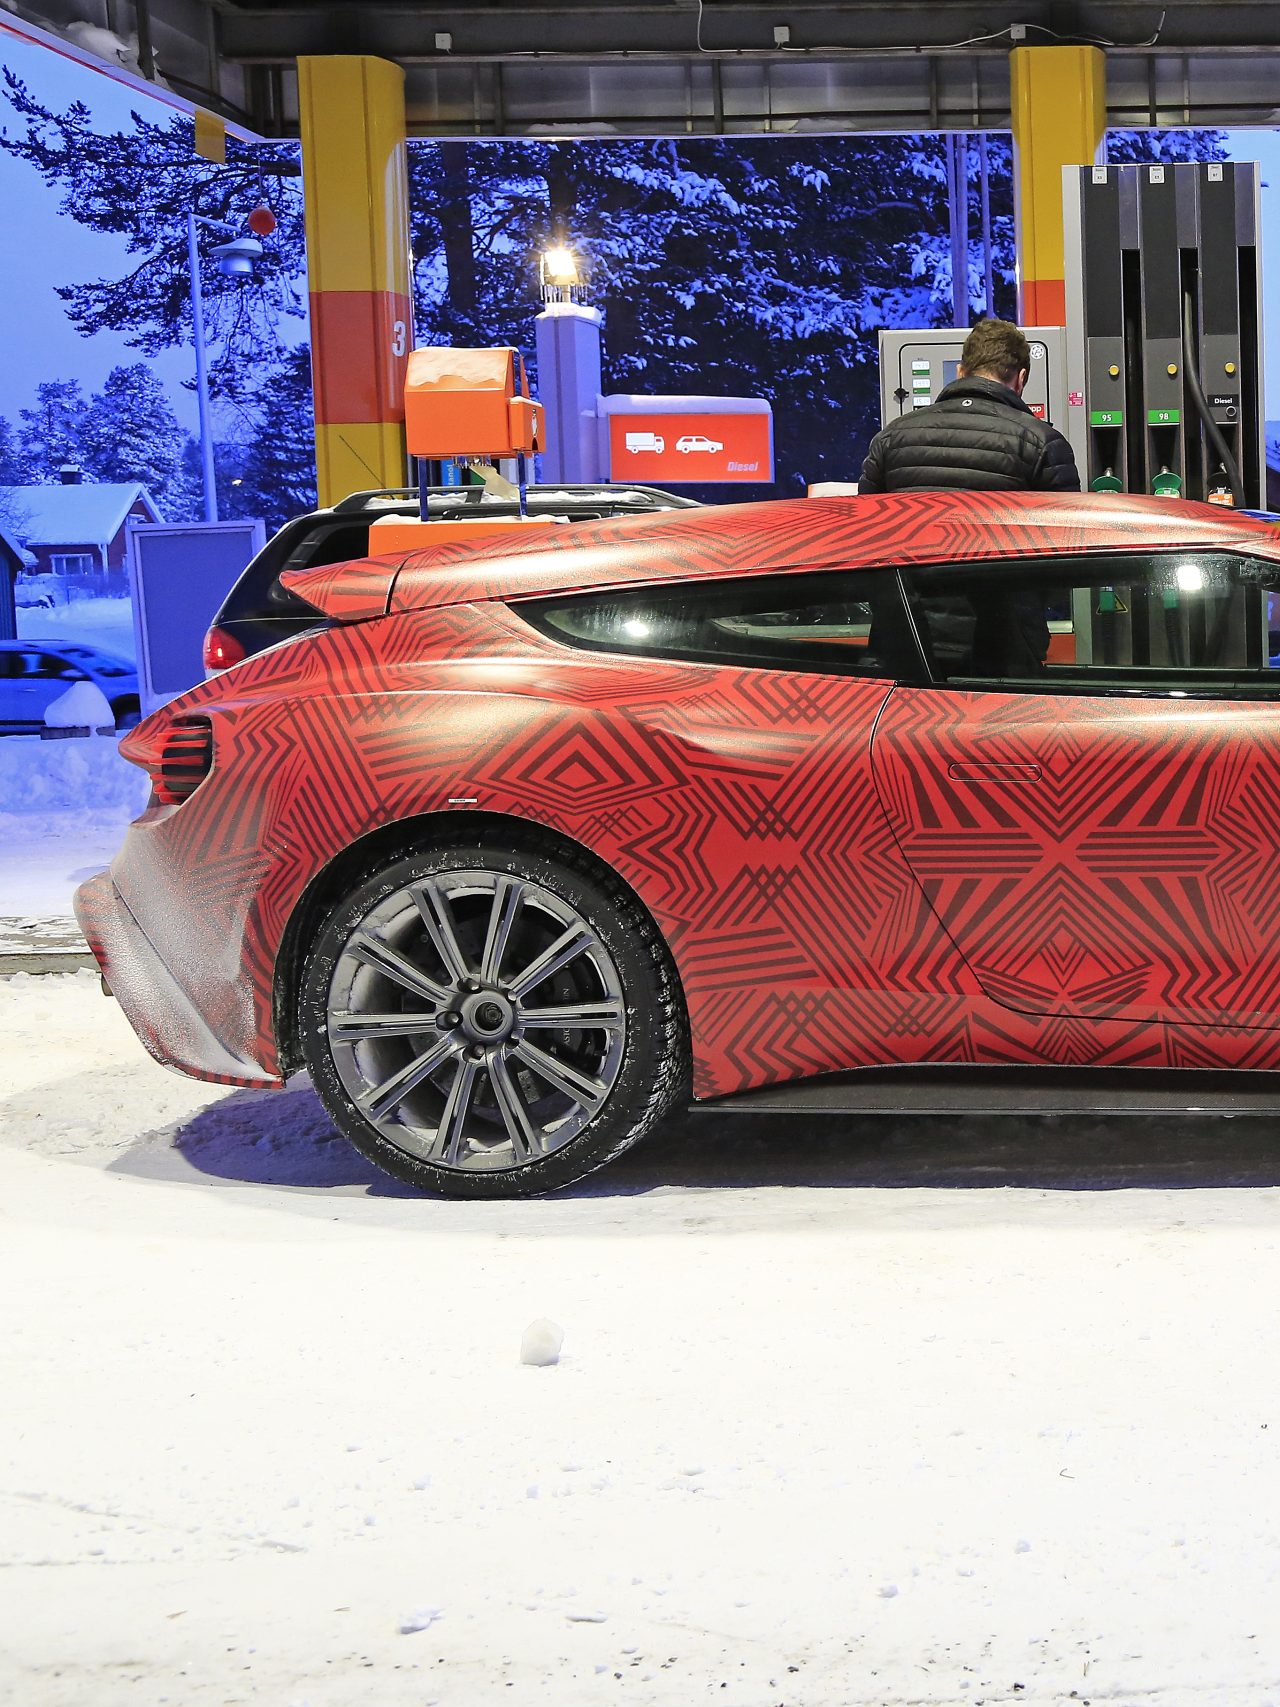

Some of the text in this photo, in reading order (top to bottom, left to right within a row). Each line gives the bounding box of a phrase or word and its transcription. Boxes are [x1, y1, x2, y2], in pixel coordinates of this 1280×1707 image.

[392, 320, 407, 357] 3
[1101, 414, 1112, 422] 95
[727, 461, 759, 472] Diesel
